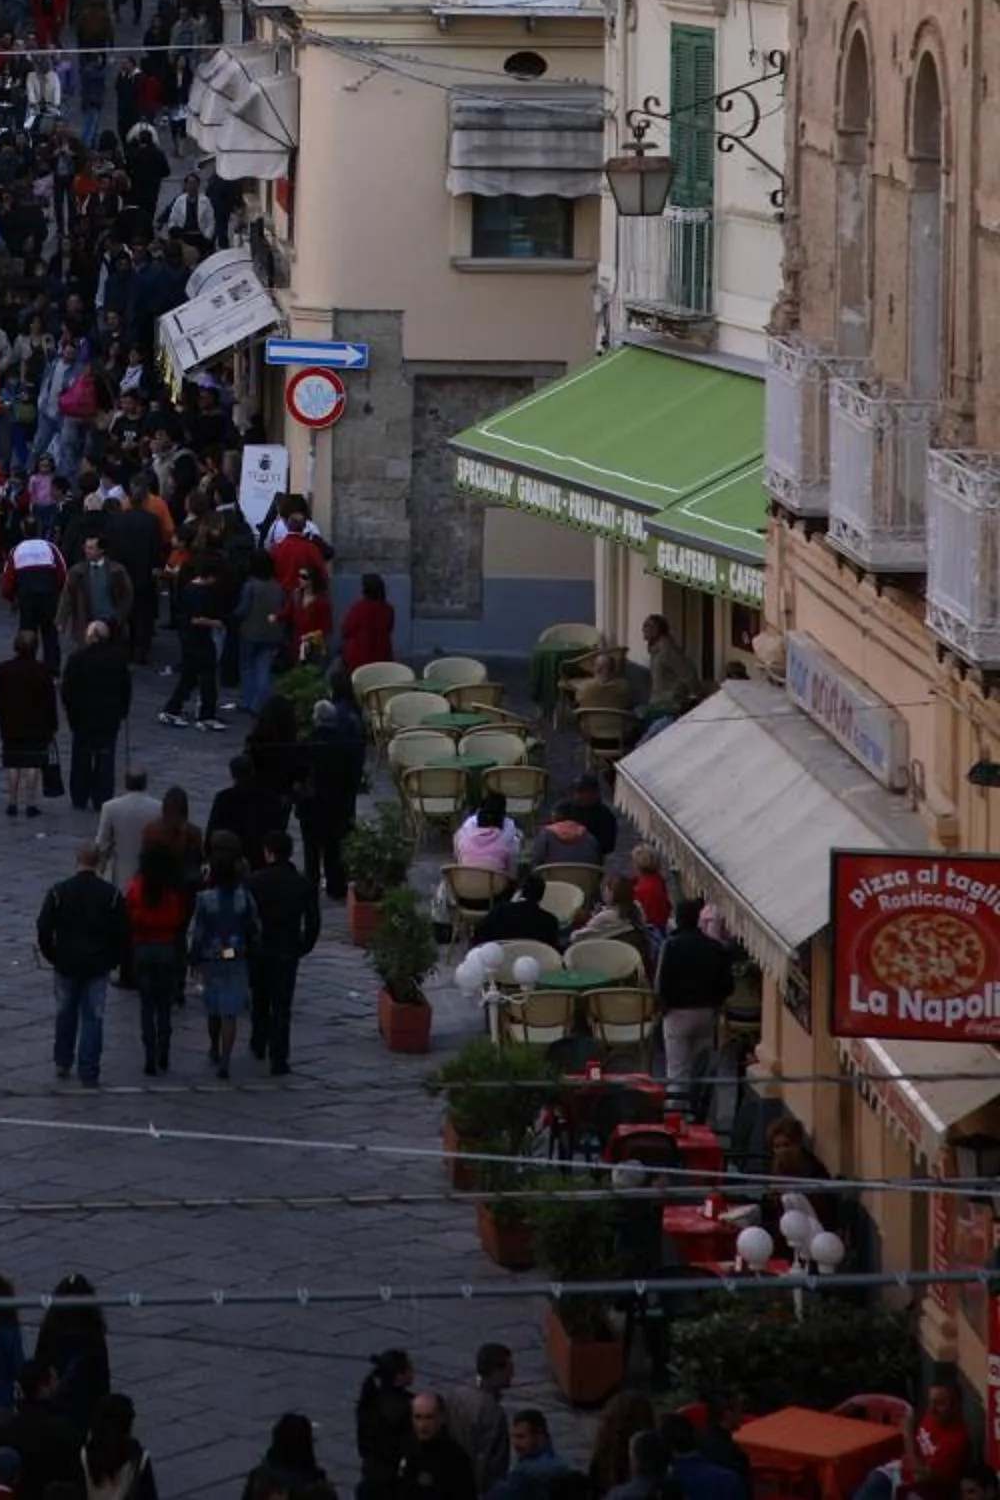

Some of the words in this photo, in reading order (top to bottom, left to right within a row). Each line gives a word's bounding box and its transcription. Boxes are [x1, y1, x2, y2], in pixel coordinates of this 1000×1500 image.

[657, 540, 717, 585] GELATERIA
[849, 869, 909, 908] pizza
[917, 863, 938, 885] al
[878, 889, 977, 915] Rosticceria
[849, 974, 888, 1016] La
